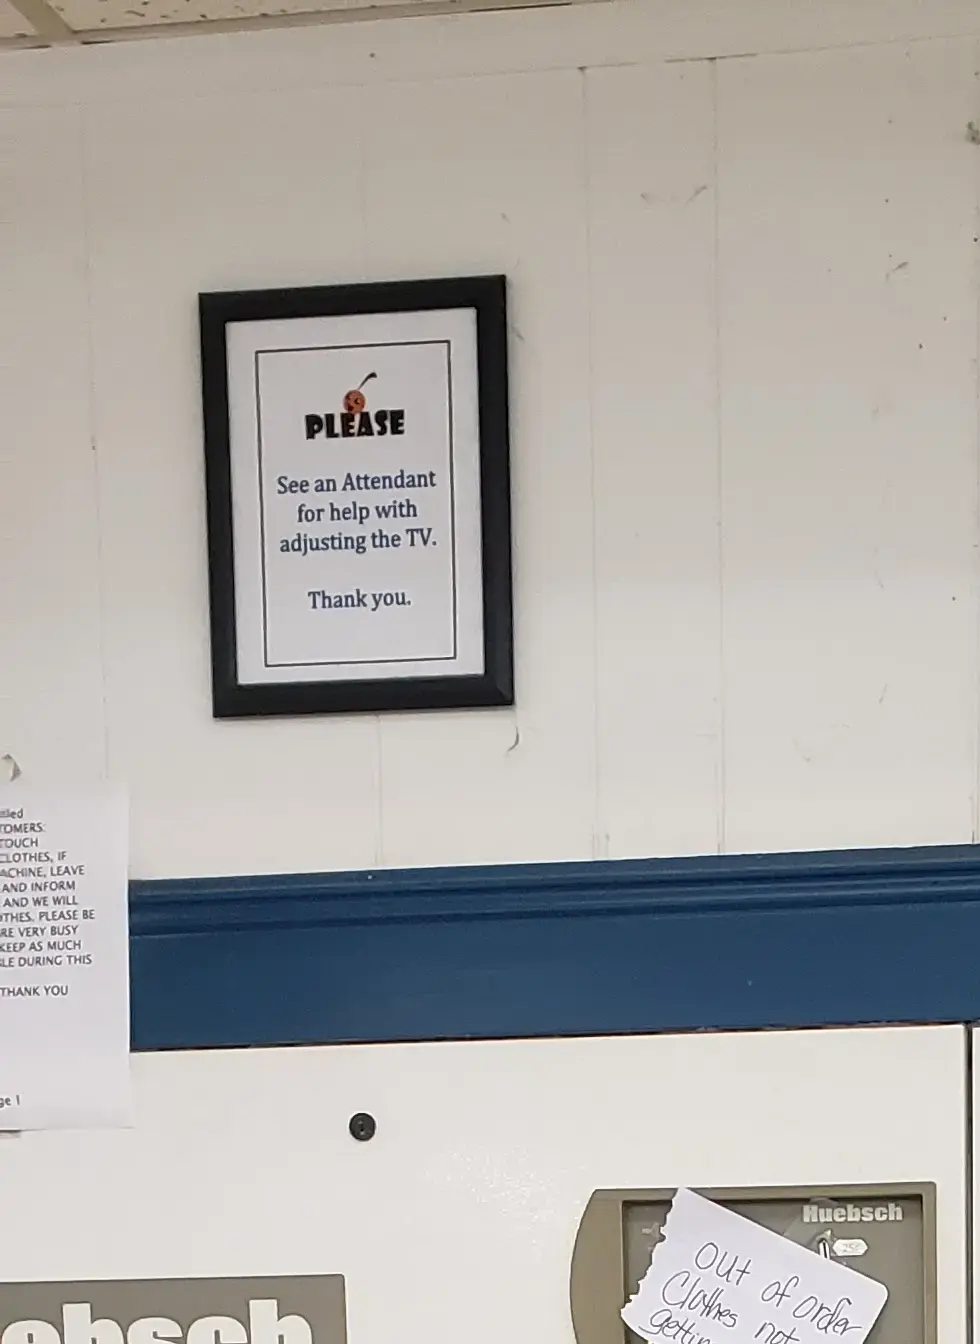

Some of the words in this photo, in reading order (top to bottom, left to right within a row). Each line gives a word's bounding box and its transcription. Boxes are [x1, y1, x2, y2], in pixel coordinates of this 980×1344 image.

[304, 409, 405, 440] PLEASE
[276, 475, 309, 494] See
[314, 477, 337, 492] an
[341, 469, 437, 491] Attendant
[297, 503, 325, 523] for
[329, 501, 370, 525] help
[375, 499, 418, 519] with
[279, 532, 367, 557] adjusting
[371, 529, 402, 549] the
[405, 528, 437, 547] TV.
[307, 589, 368, 609] Thank
[371, 590, 412, 612] you.
[58, 851, 67, 861] IF
[50, 865, 85, 876] LEAVE
[2, 882, 28, 893] AND
[31, 881, 76, 892] INFORM
[3, 897, 29, 907] AND
[32, 896, 48, 907] WE
[52, 895, 78, 905] WILL
[39, 909, 78, 921] PLEASE
[83, 909, 95, 919] BE
[18, 926, 46, 937] VERY
[50, 925, 78, 935] BUSY
[28, 941, 43, 951] AS
[47, 939, 81, 950] MUCH
[18, 955, 62, 967] DURING
[66, 954, 92, 964] THIS
[0, 986, 40, 997] THANK
[43, 985, 68, 996] YOU
[802, 1202, 904, 1224] Huebsch
[761, 1275, 799, 1308] of
